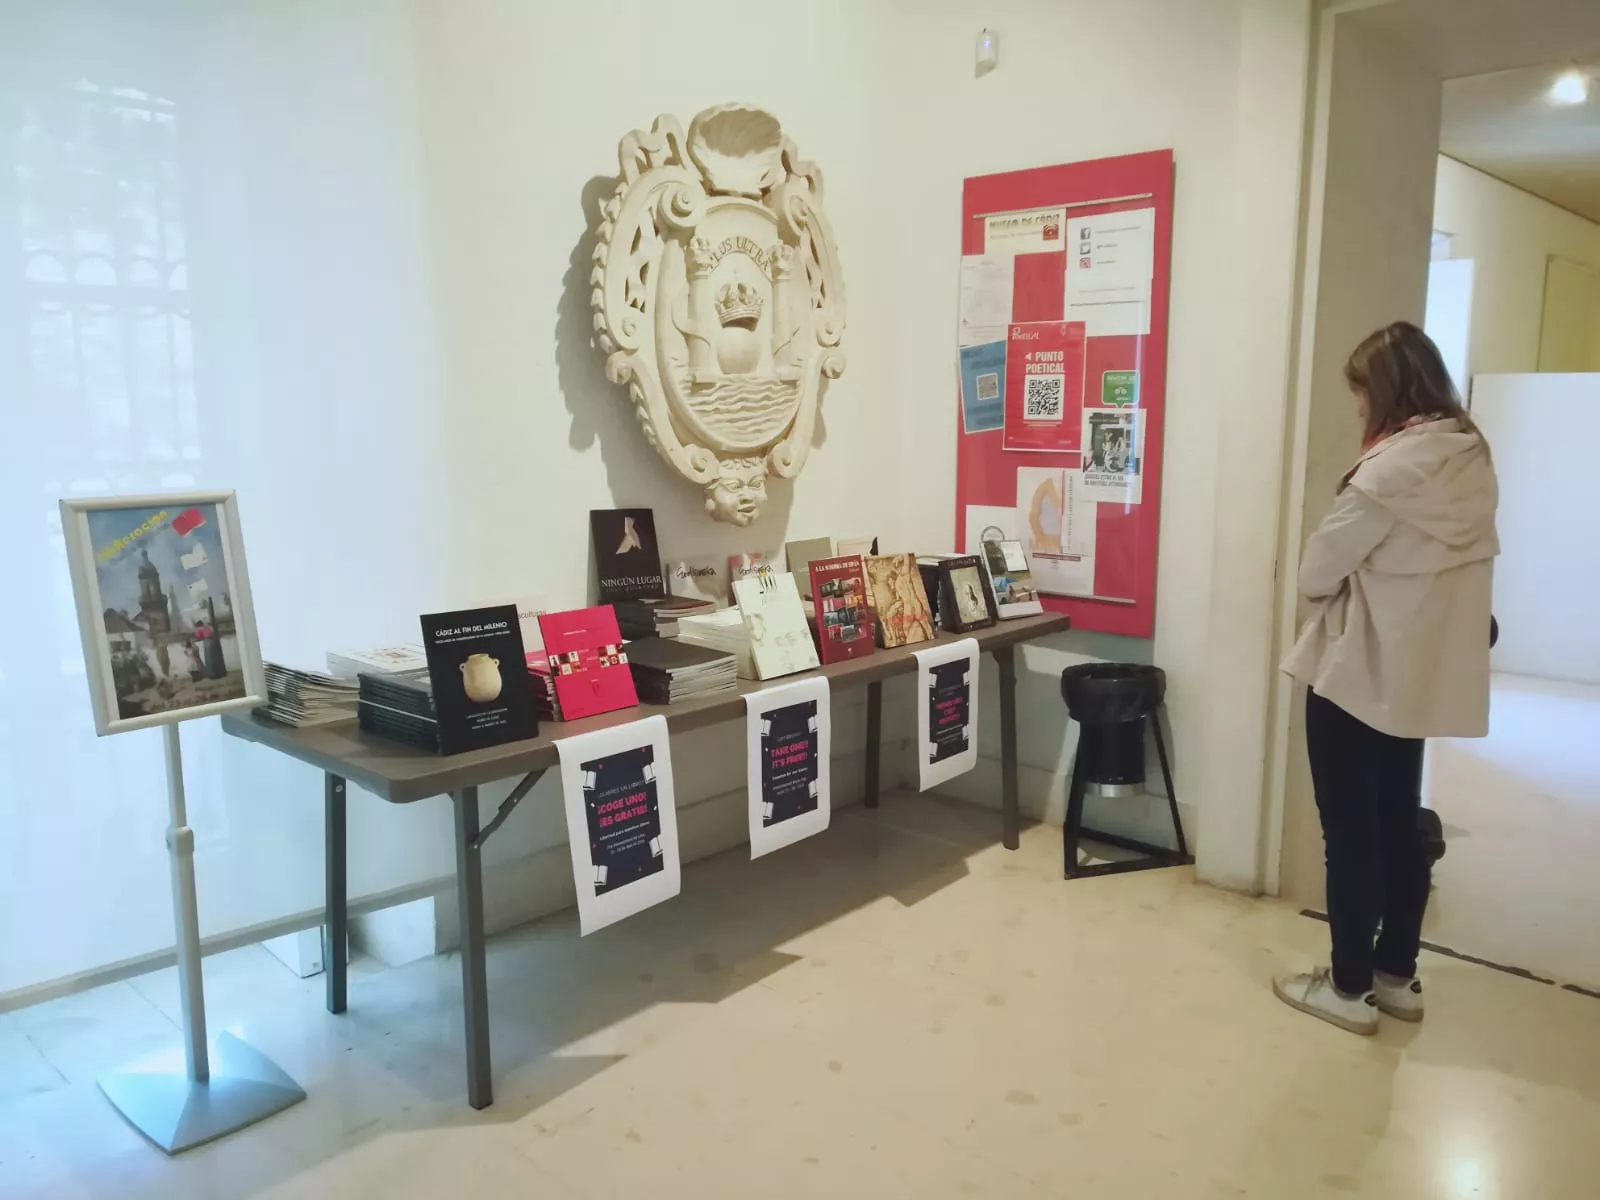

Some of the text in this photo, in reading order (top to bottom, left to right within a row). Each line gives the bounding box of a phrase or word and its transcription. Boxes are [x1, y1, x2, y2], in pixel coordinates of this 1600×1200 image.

[1035, 351, 1064, 361] PUNTO
[1025, 363, 1066, 373] POETICAL
[601, 576, 662, 587] NINGÚN LUGAR
[435, 628, 453, 637] CÁDIZ
[483, 621, 507, 630] MILENIO
